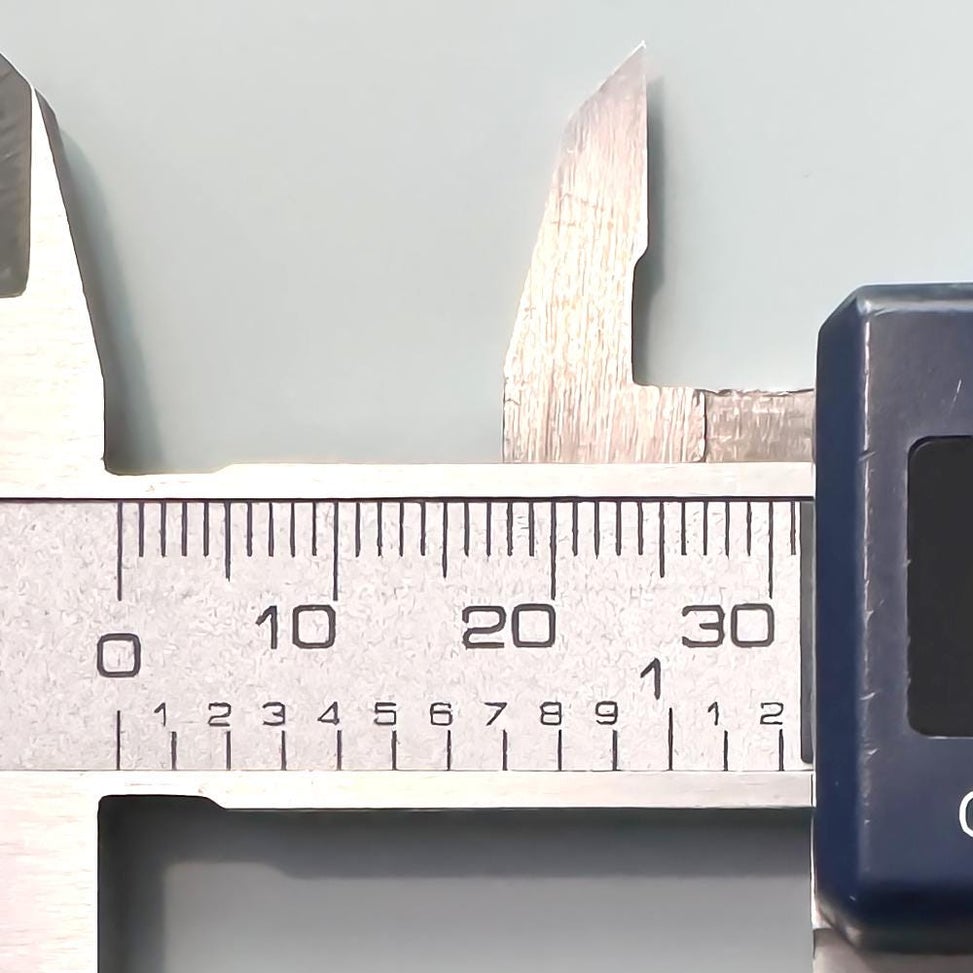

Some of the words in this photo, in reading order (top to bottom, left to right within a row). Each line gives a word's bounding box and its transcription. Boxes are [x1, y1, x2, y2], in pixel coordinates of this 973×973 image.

[256, 605, 337, 650] 10
[461, 603, 557, 650] 20
[681, 602, 775, 649] 30
[97, 632, 142, 679] 0
[640, 657, 662, 701] 1
[153, 701, 167, 726] 1
[207, 701, 232, 726] 2
[262, 701, 286, 726] 3
[317, 701, 340, 726] 4
[373, 701, 397, 726] 5
[429, 701, 453, 726] 6
[484, 701, 508, 726] 7
[539, 701, 563, 726] 8
[594, 701, 619, 726] 9
[707, 701, 720, 726] 1
[759, 701, 784, 726] 2
